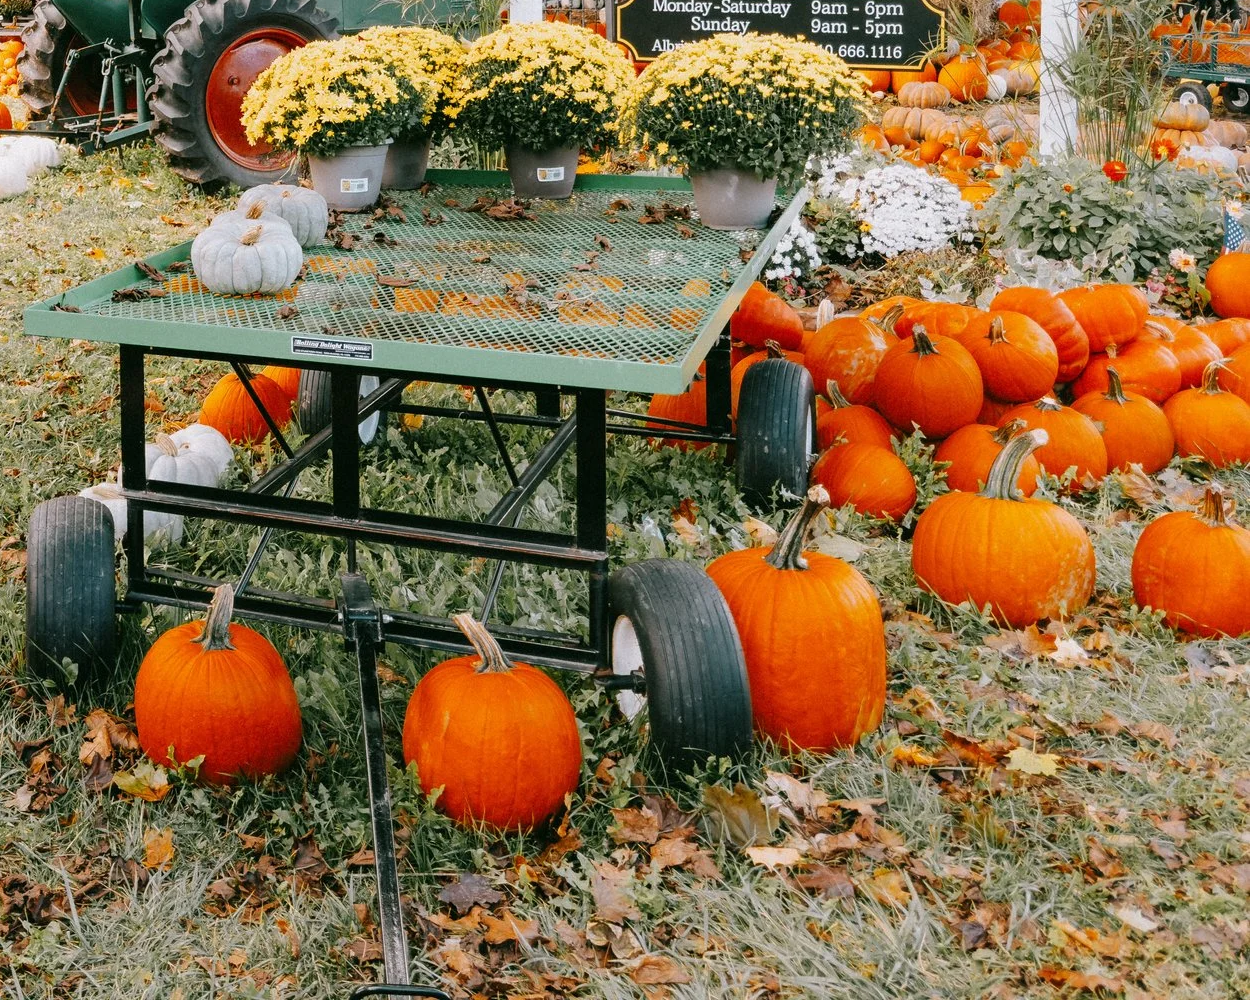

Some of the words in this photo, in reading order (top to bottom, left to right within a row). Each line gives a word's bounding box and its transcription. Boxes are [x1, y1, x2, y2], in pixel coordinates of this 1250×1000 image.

[811, 0, 848, 15] 9am
[864, 1, 904, 18] 6pm
[691, 16, 750, 35] Sunday
[811, 18, 848, 34] 9am
[864, 19, 904, 38] 5pm
